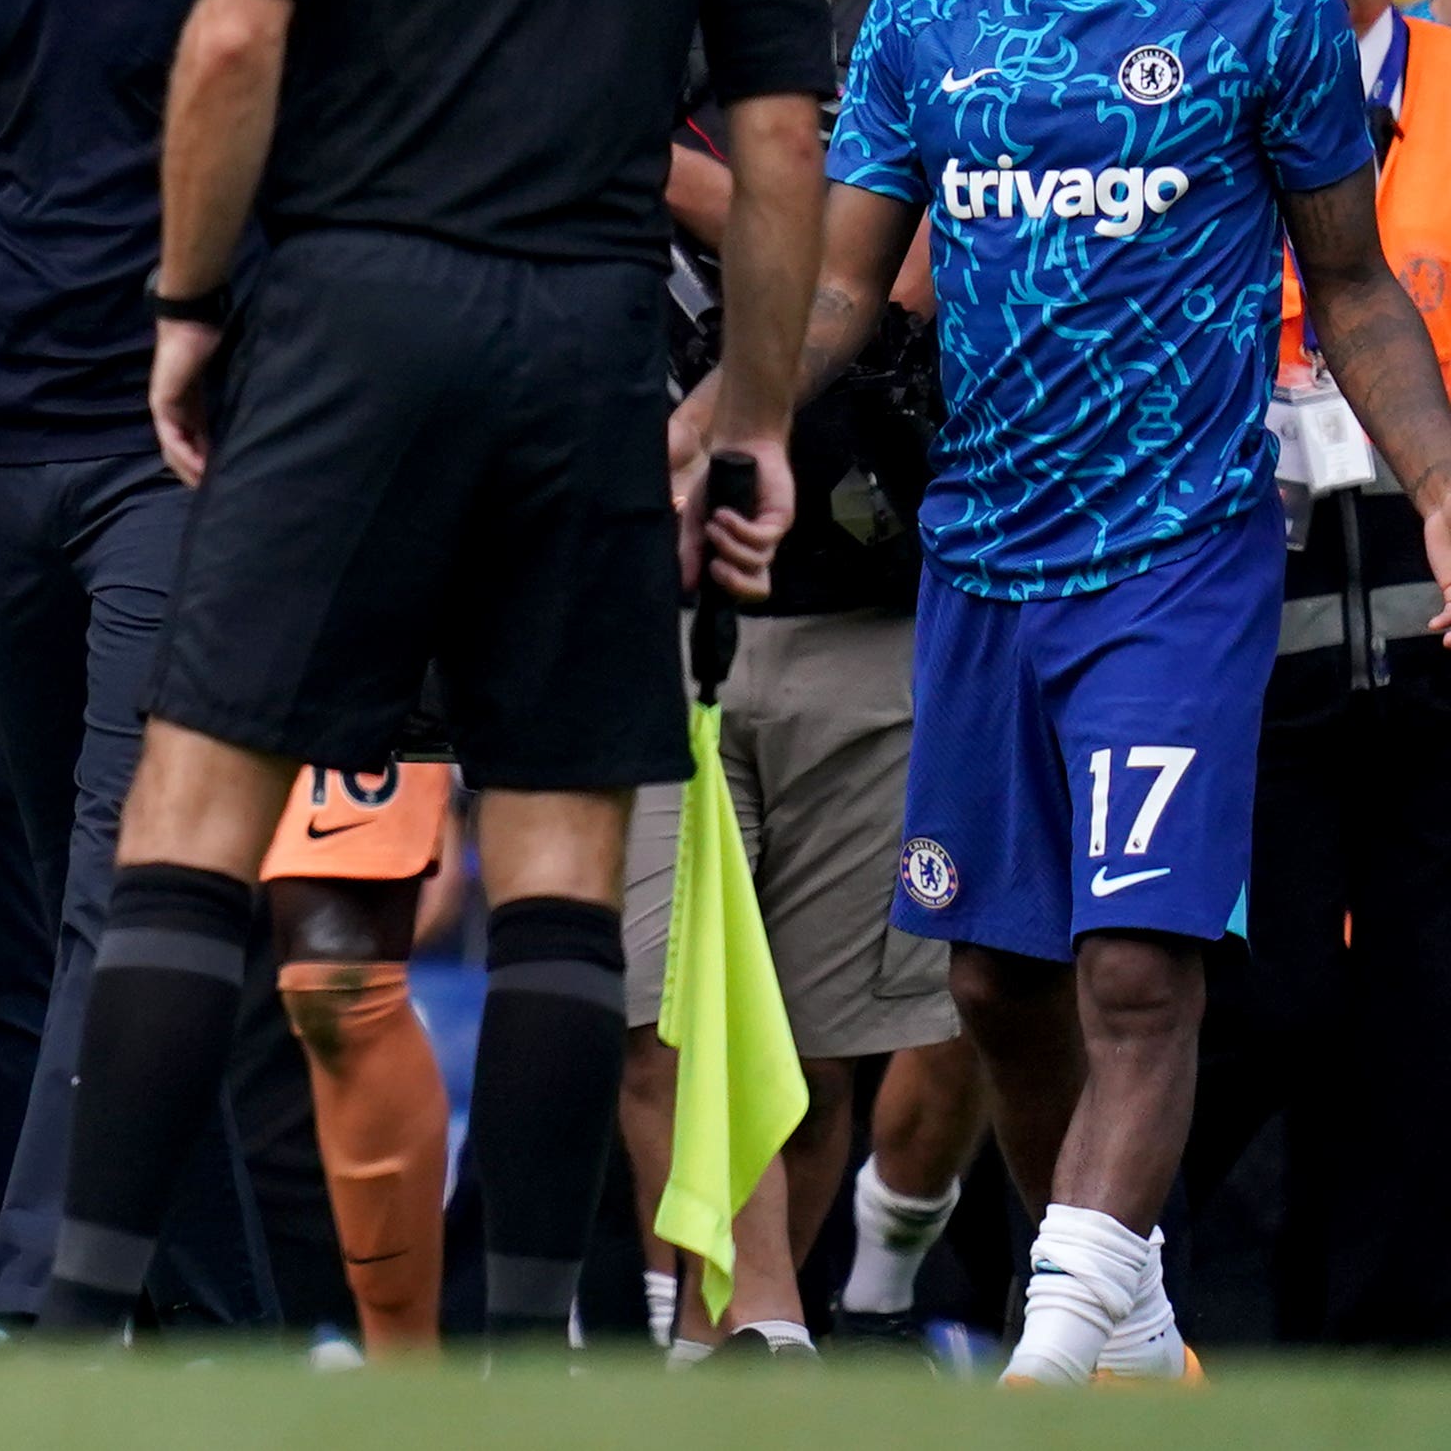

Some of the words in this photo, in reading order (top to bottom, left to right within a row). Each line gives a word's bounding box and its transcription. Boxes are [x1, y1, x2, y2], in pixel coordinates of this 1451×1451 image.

[1131, 50, 1171, 64] CHELSEA
[941, 154, 1189, 237] trivago
[1088, 745, 1197, 858] 17
[908, 841, 946, 860] CHELSEA
